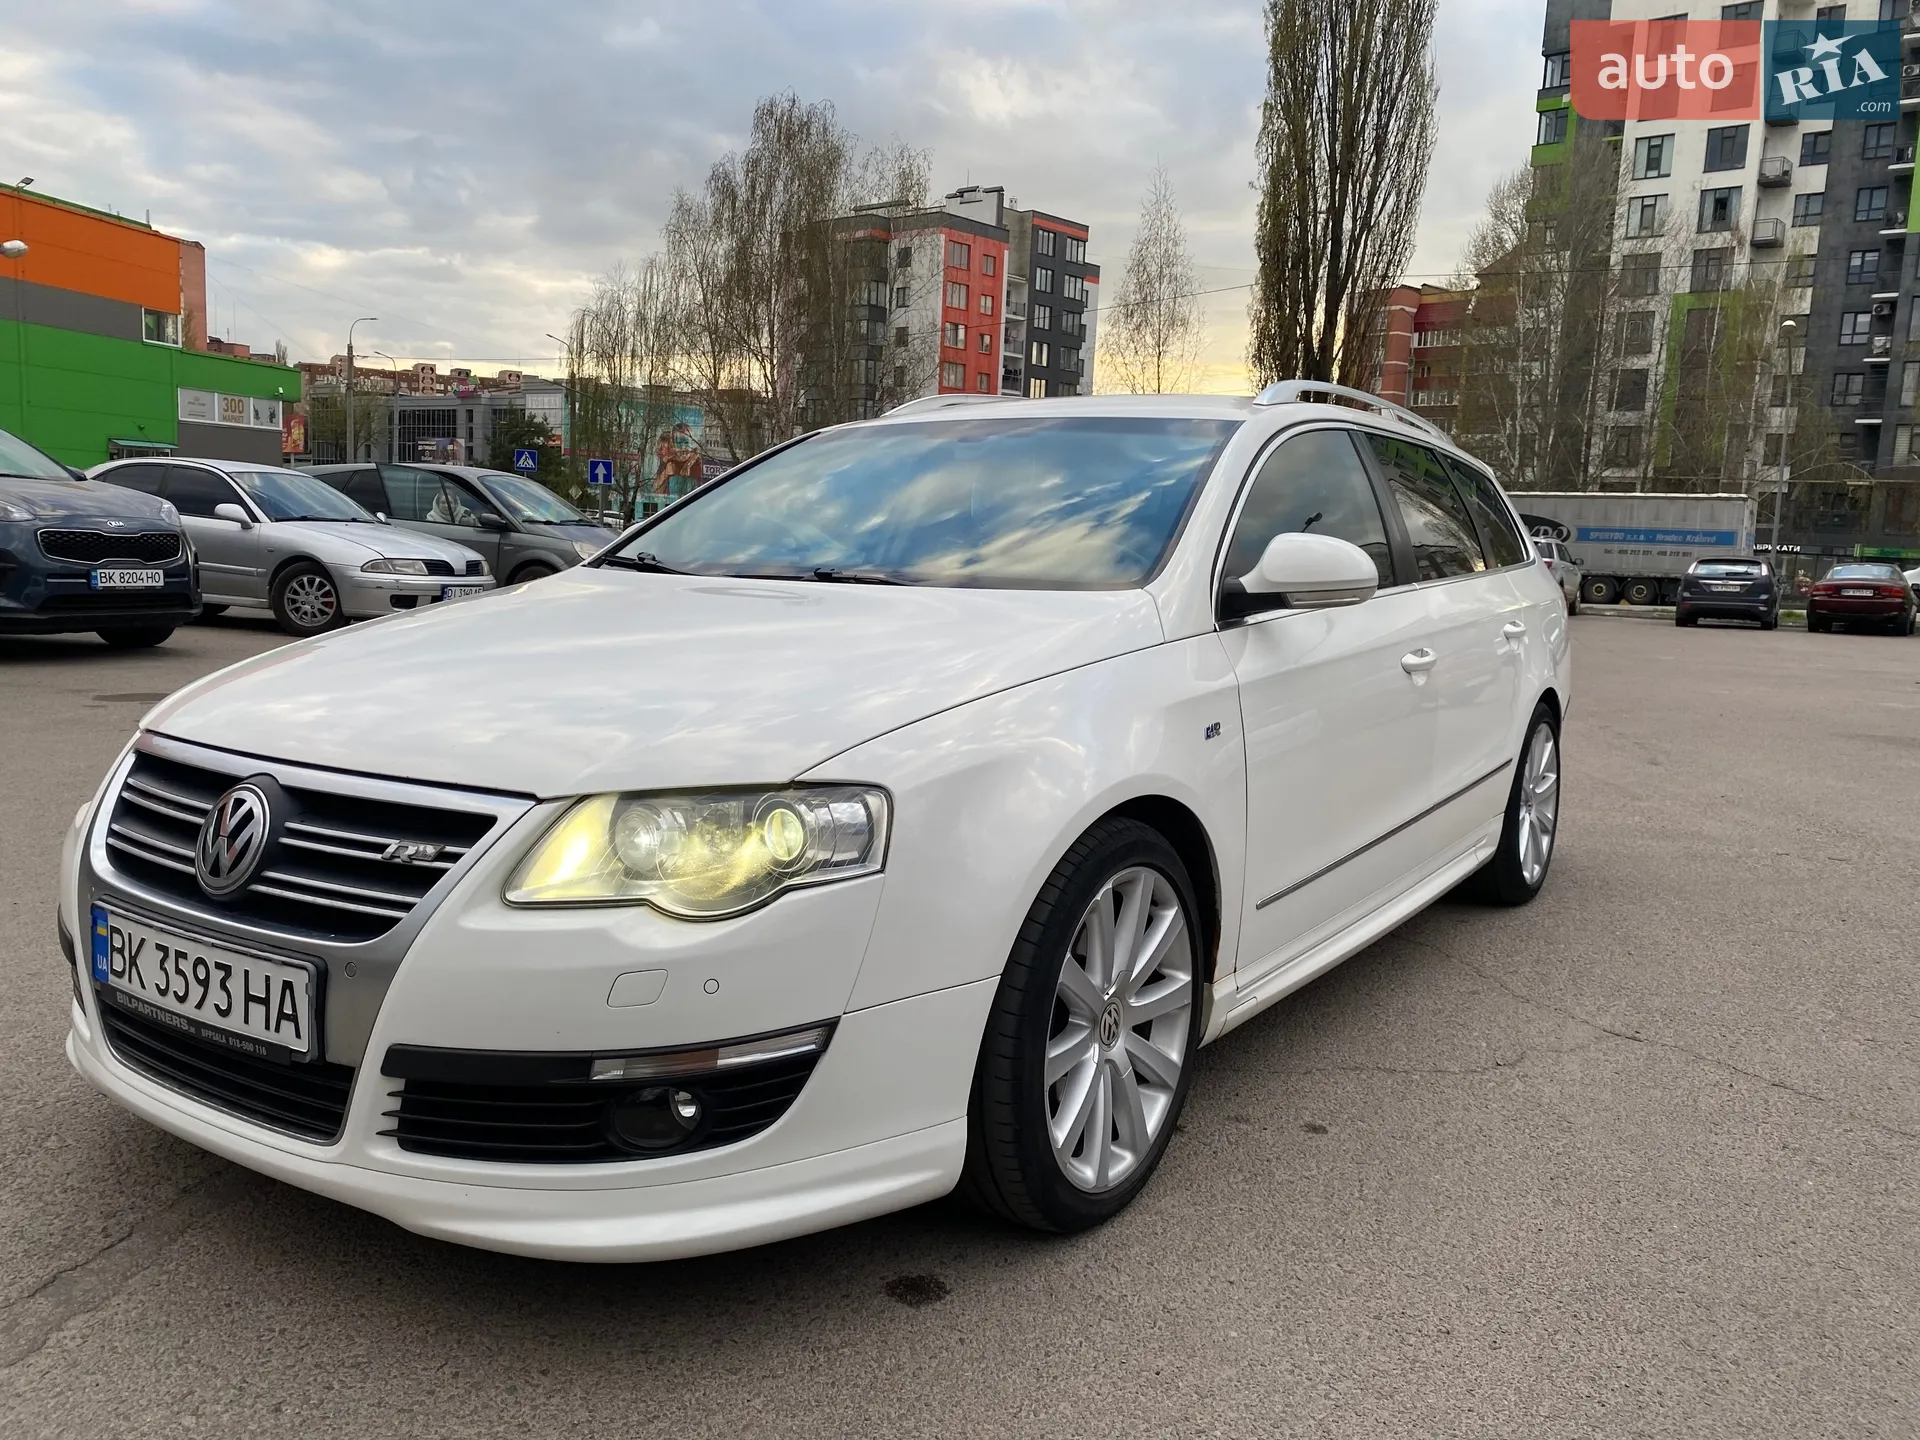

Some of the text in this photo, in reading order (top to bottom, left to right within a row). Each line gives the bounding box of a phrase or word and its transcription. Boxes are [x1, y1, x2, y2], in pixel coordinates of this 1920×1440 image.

[222, 397, 244, 414] 300
[1655, 533, 1683, 542] Hradec
[99, 572, 161, 584] BK 8204 HO
[97, 954, 108, 974] UA
[108, 924, 302, 1040] BK 3593 HA
[201, 1028, 226, 1044] UPPSALA
